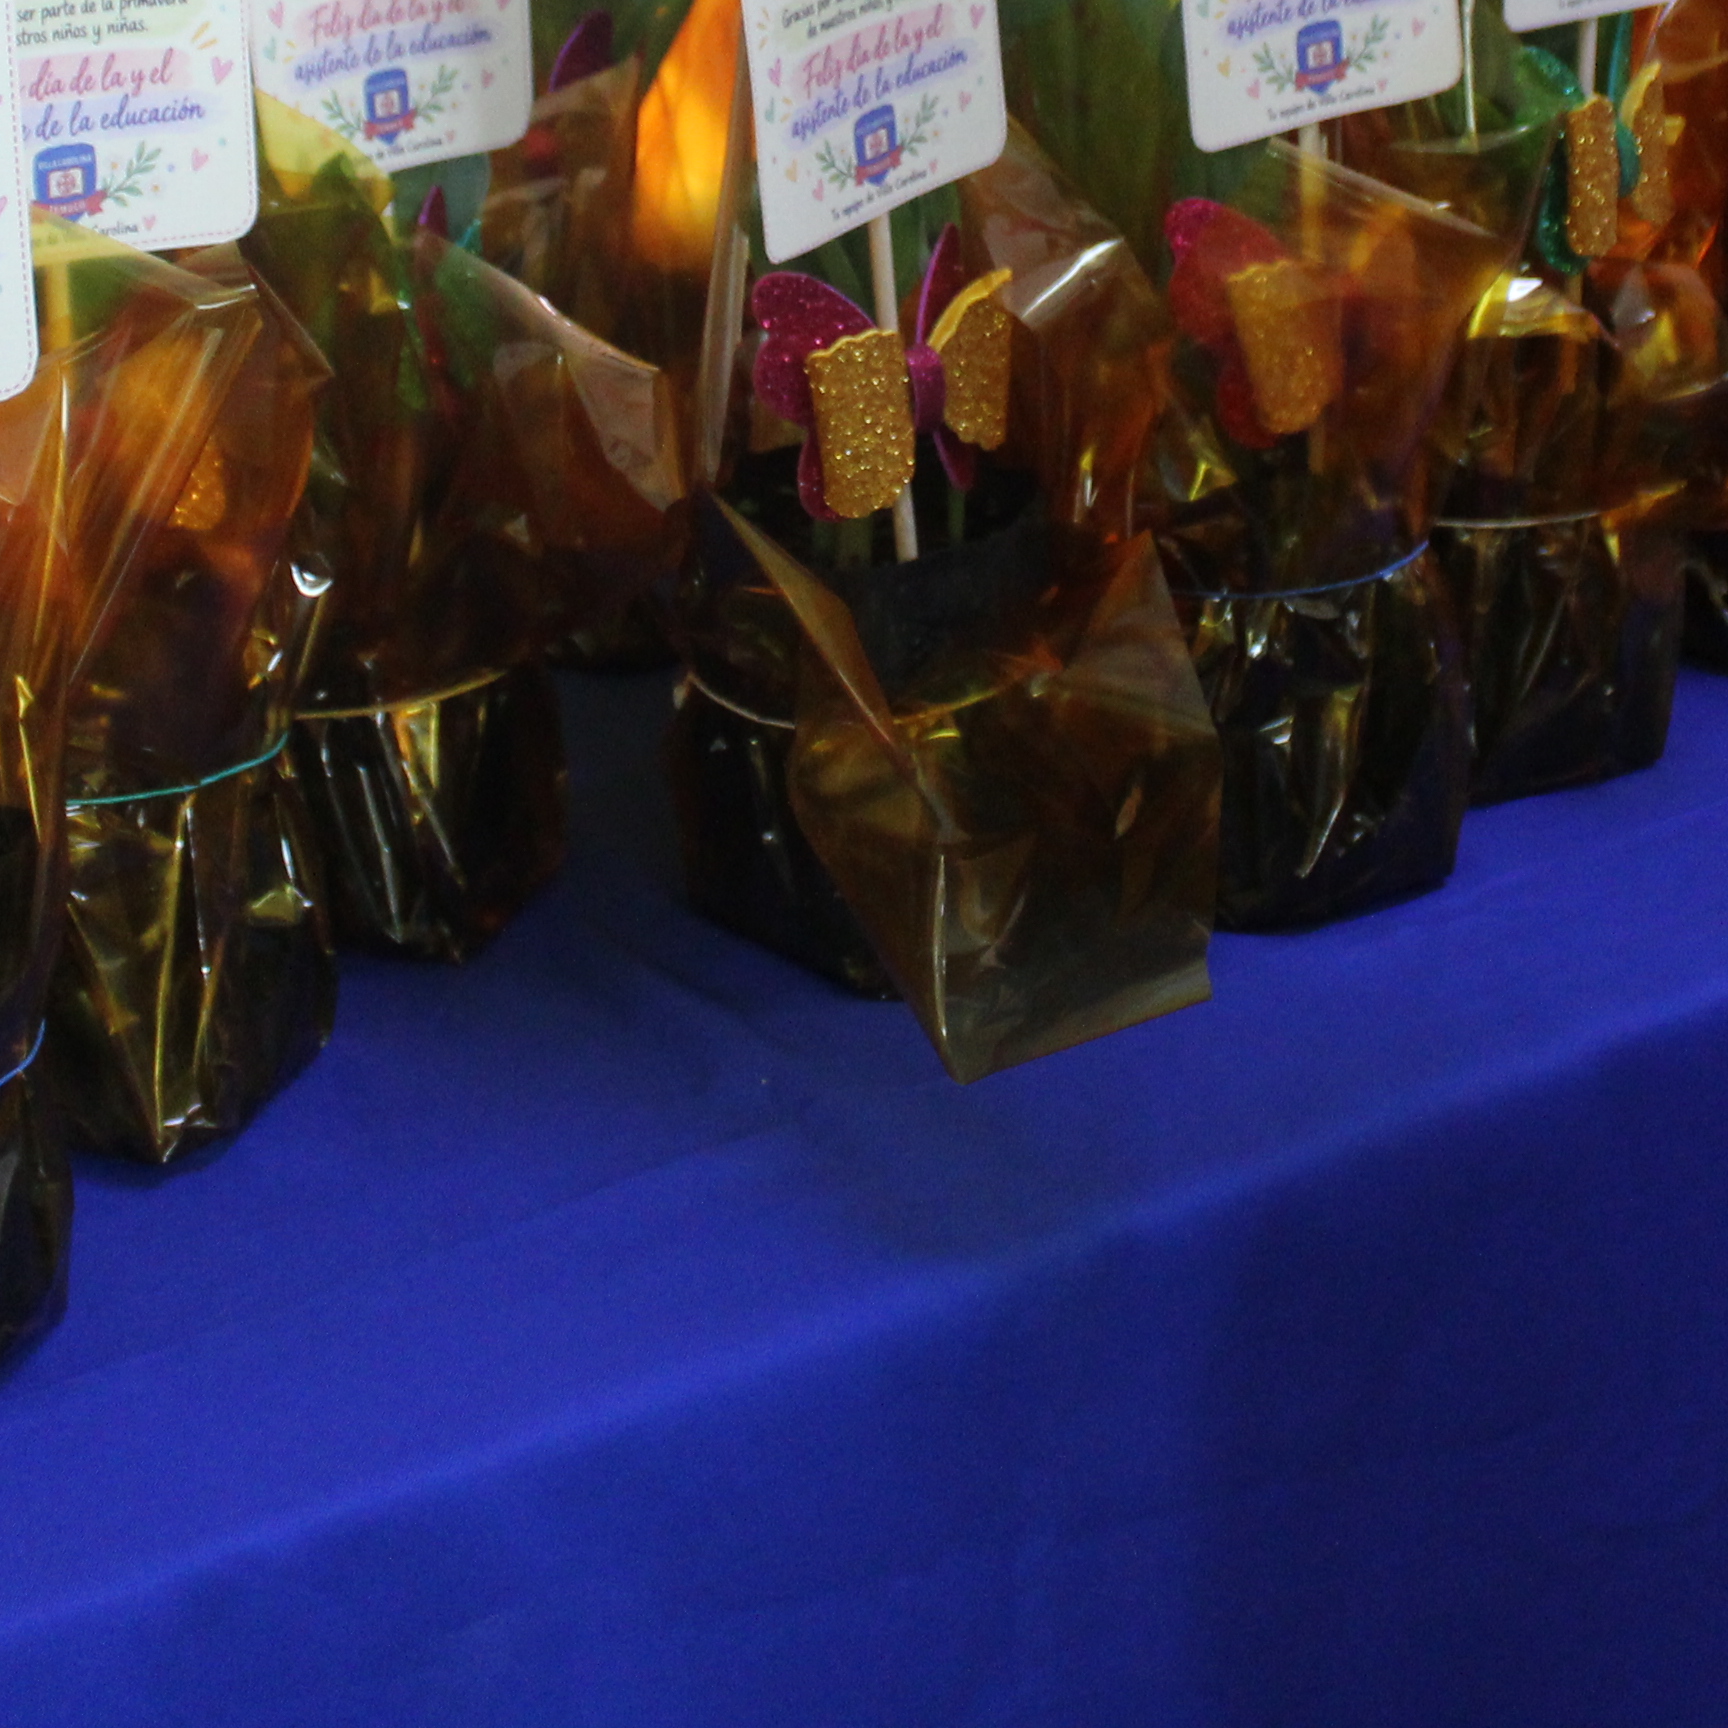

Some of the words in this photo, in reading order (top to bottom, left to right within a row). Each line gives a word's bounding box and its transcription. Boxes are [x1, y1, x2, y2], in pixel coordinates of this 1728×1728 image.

[16, 9, 36, 22] ser
[53, 23, 88, 41] niños
[93, 25, 101, 45] y
[107, 17, 148, 34] niñas.
[27, 59, 65, 100] día
[70, 57, 95, 95] de
[102, 53, 125, 92] la
[131, 69, 145, 97] y
[151, 47, 173, 84] el
[34, 104, 62, 138] de
[69, 100, 94, 136] la
[101, 92, 205, 130] educación
